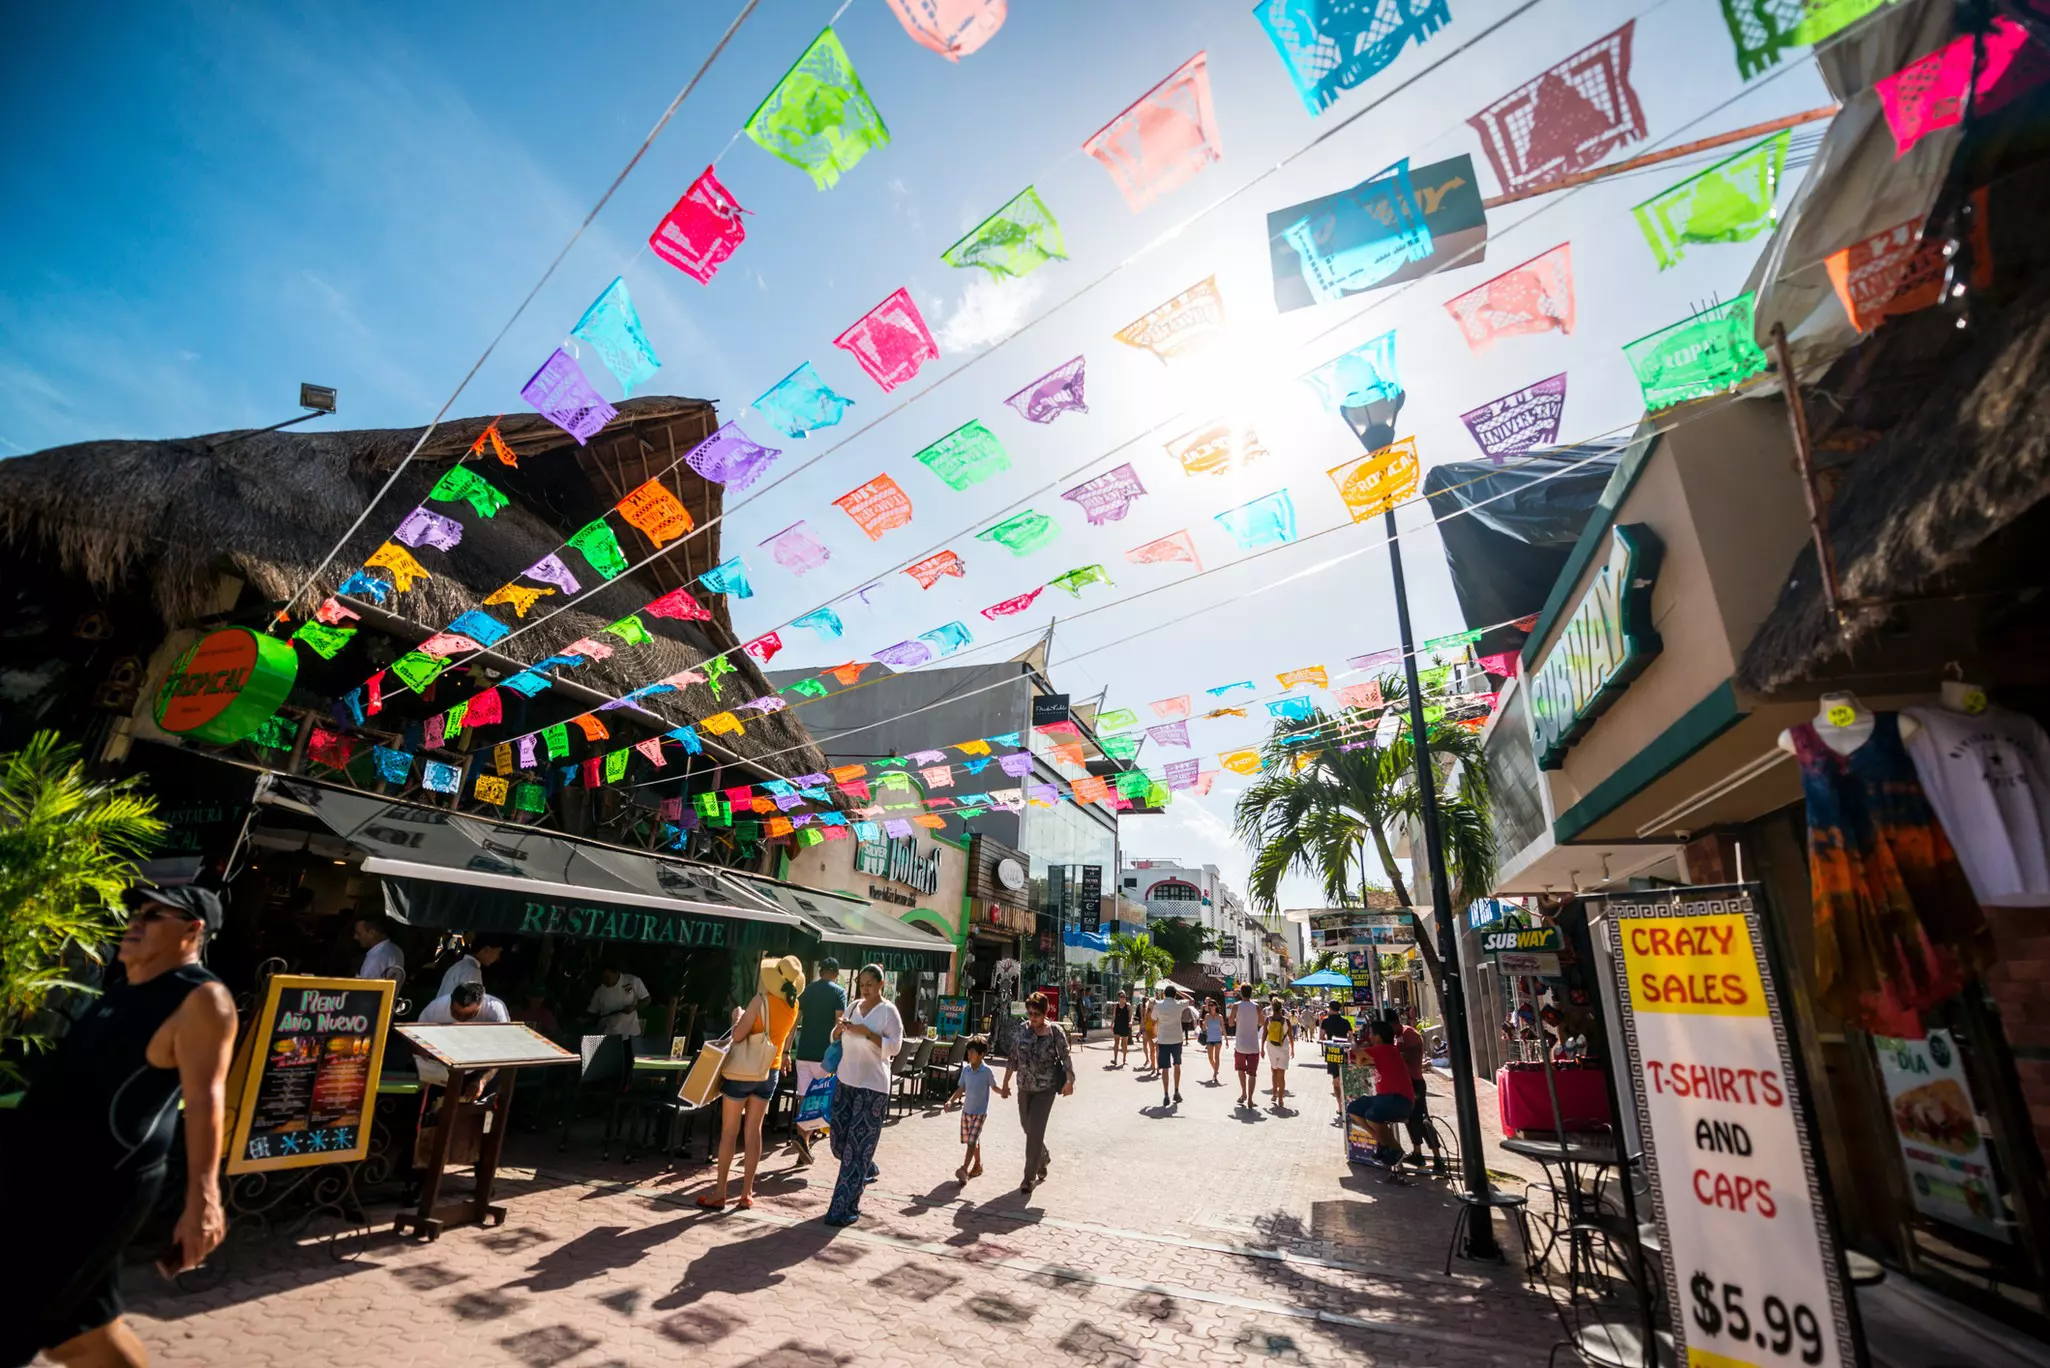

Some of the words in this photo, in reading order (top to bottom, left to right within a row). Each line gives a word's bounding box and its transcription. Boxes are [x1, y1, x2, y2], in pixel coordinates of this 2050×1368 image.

[1532, 527, 1632, 760] SUBWAY
[162, 666, 244, 698] TROPICAL
[520, 902, 726, 948] RESTAURANTE
[1484, 928, 1553, 951] SUBWAY
[1632, 925, 1733, 957] CRAZY
[861, 949, 926, 971] MEXICANO
[1641, 973, 1748, 1006] SALES
[1647, 1060, 1783, 1108] T-SHIRTS
[1695, 1118, 1753, 1157] AND
[1693, 1168, 1777, 1219] CAPS
[1690, 1270, 1824, 1367] $5.99
